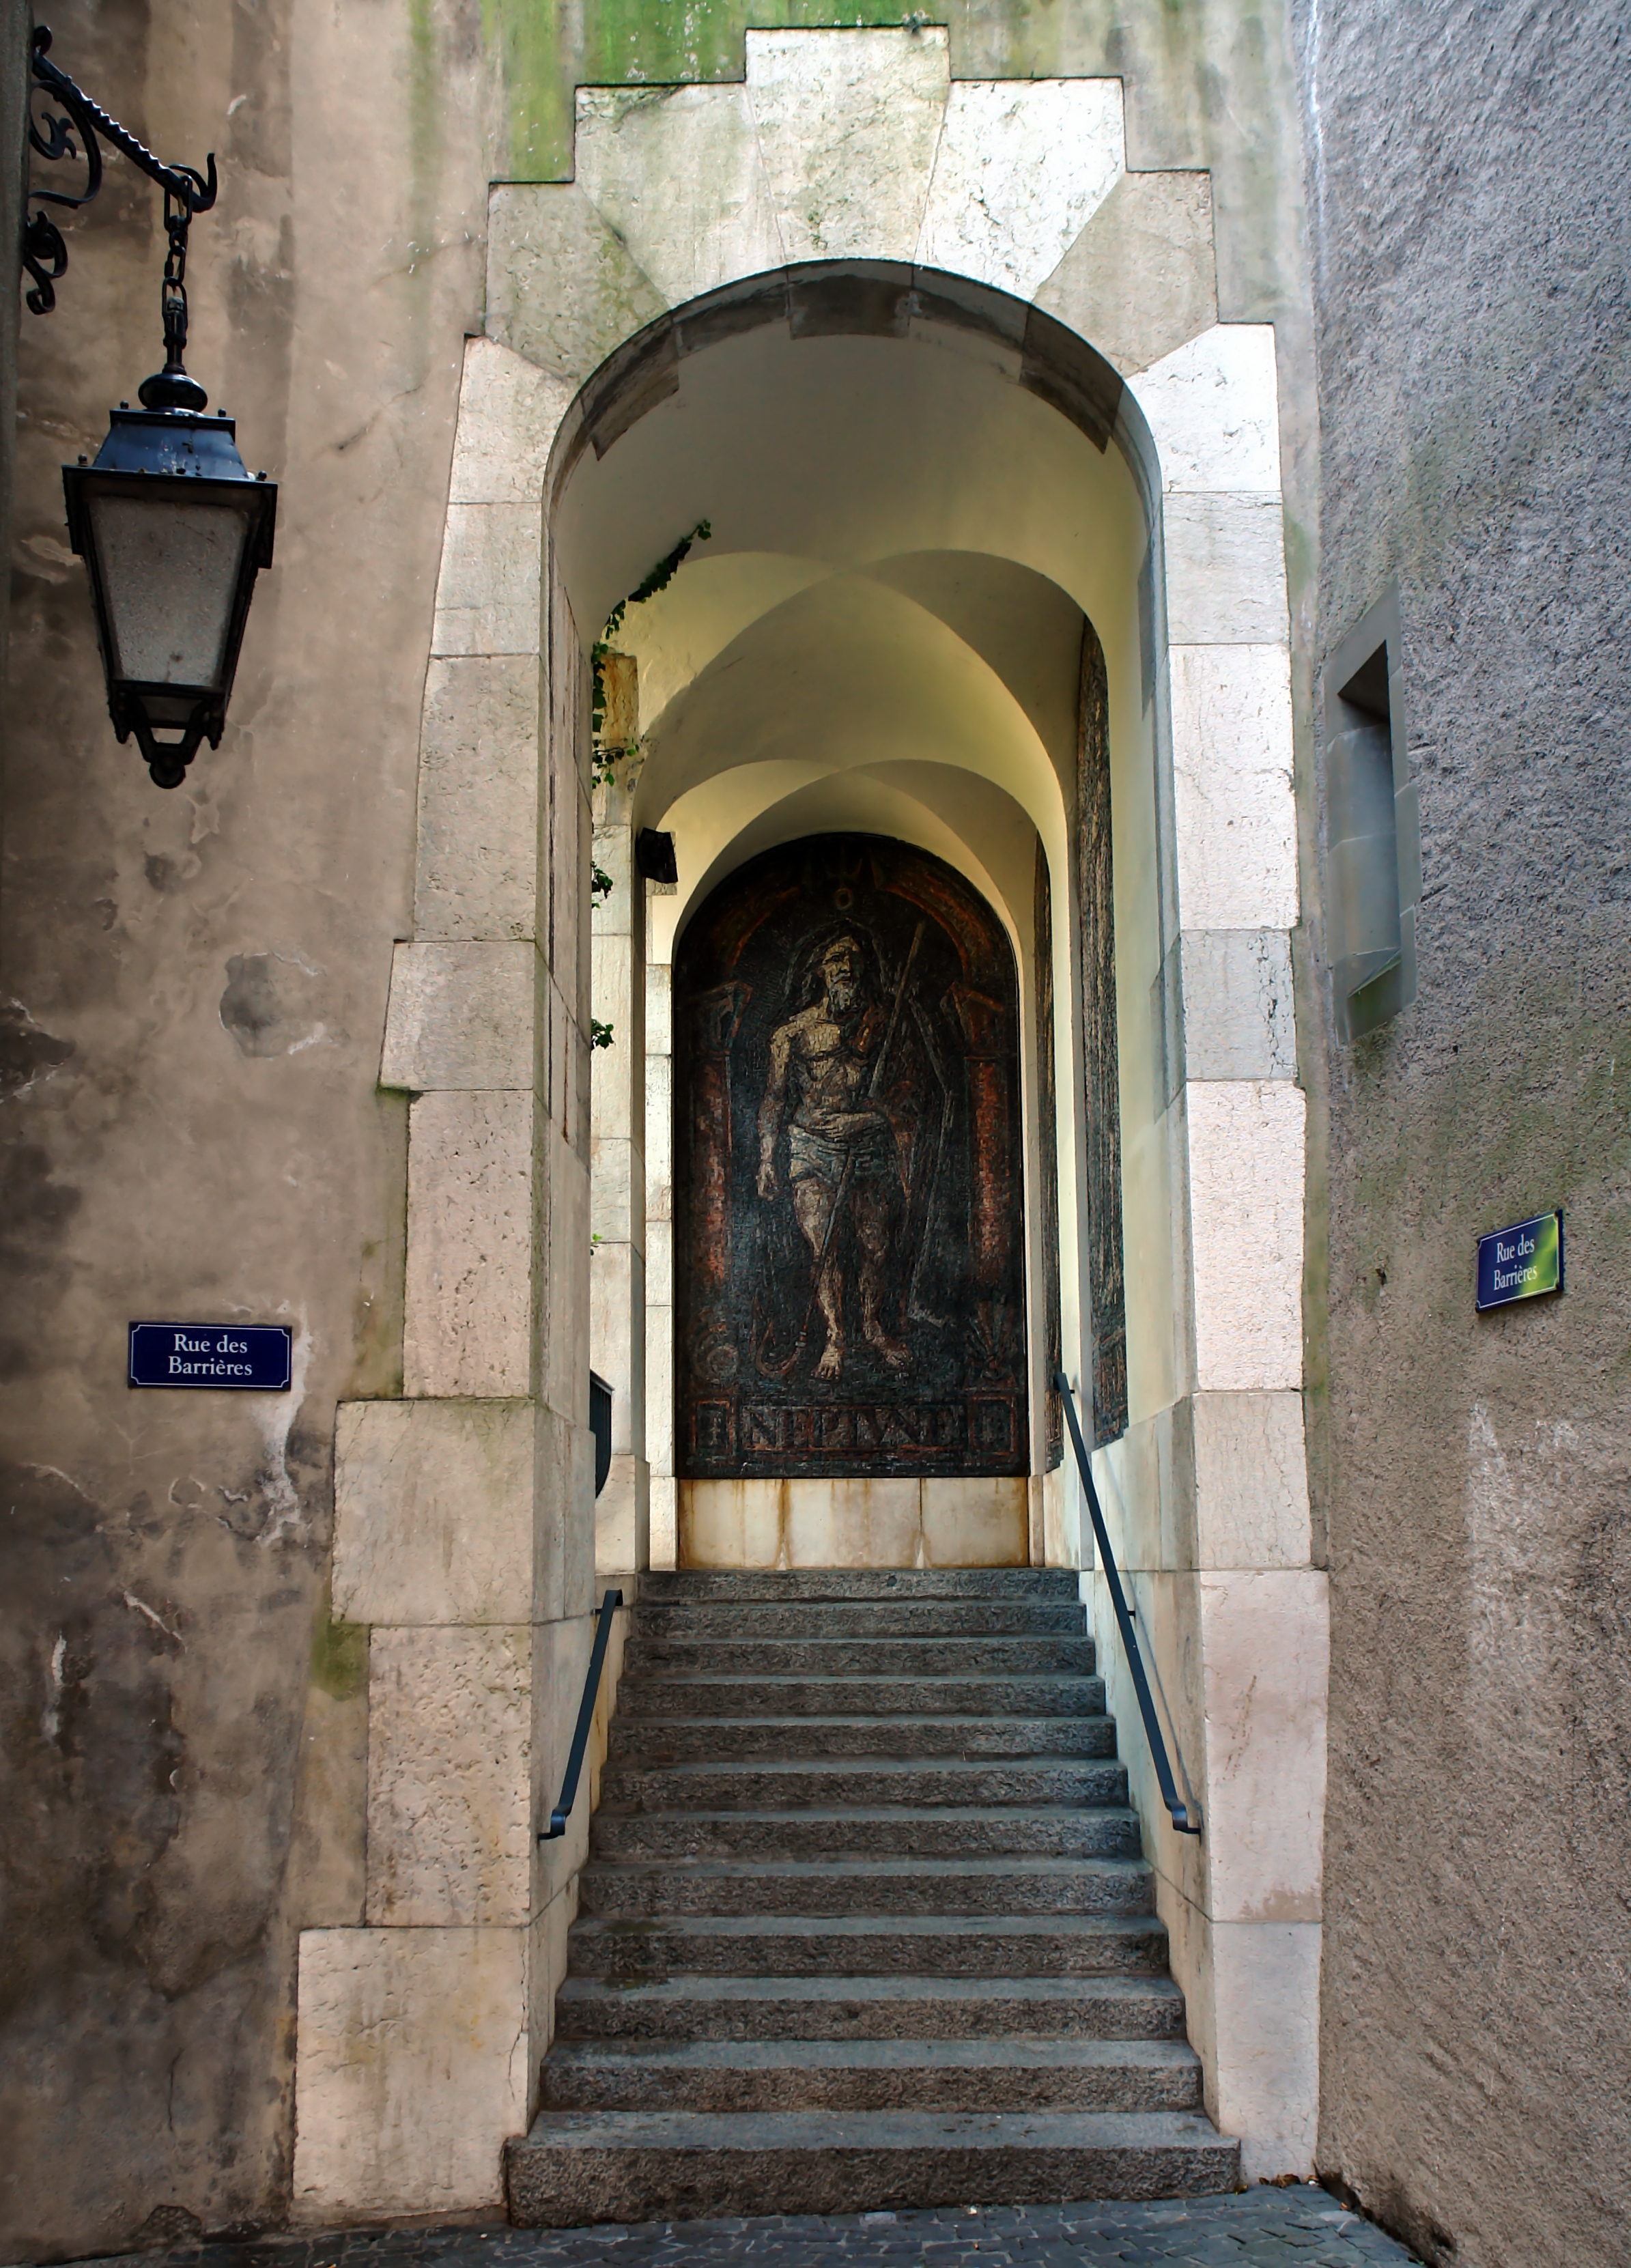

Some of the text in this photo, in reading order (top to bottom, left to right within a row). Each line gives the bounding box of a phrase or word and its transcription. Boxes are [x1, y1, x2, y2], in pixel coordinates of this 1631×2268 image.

[1496, 1233, 1535, 1263] Rue des
[1493, 1264, 1538, 1290] Barrières
[173, 1333, 248, 1353] Rue des
[168, 1356, 253, 1376] Barrières
